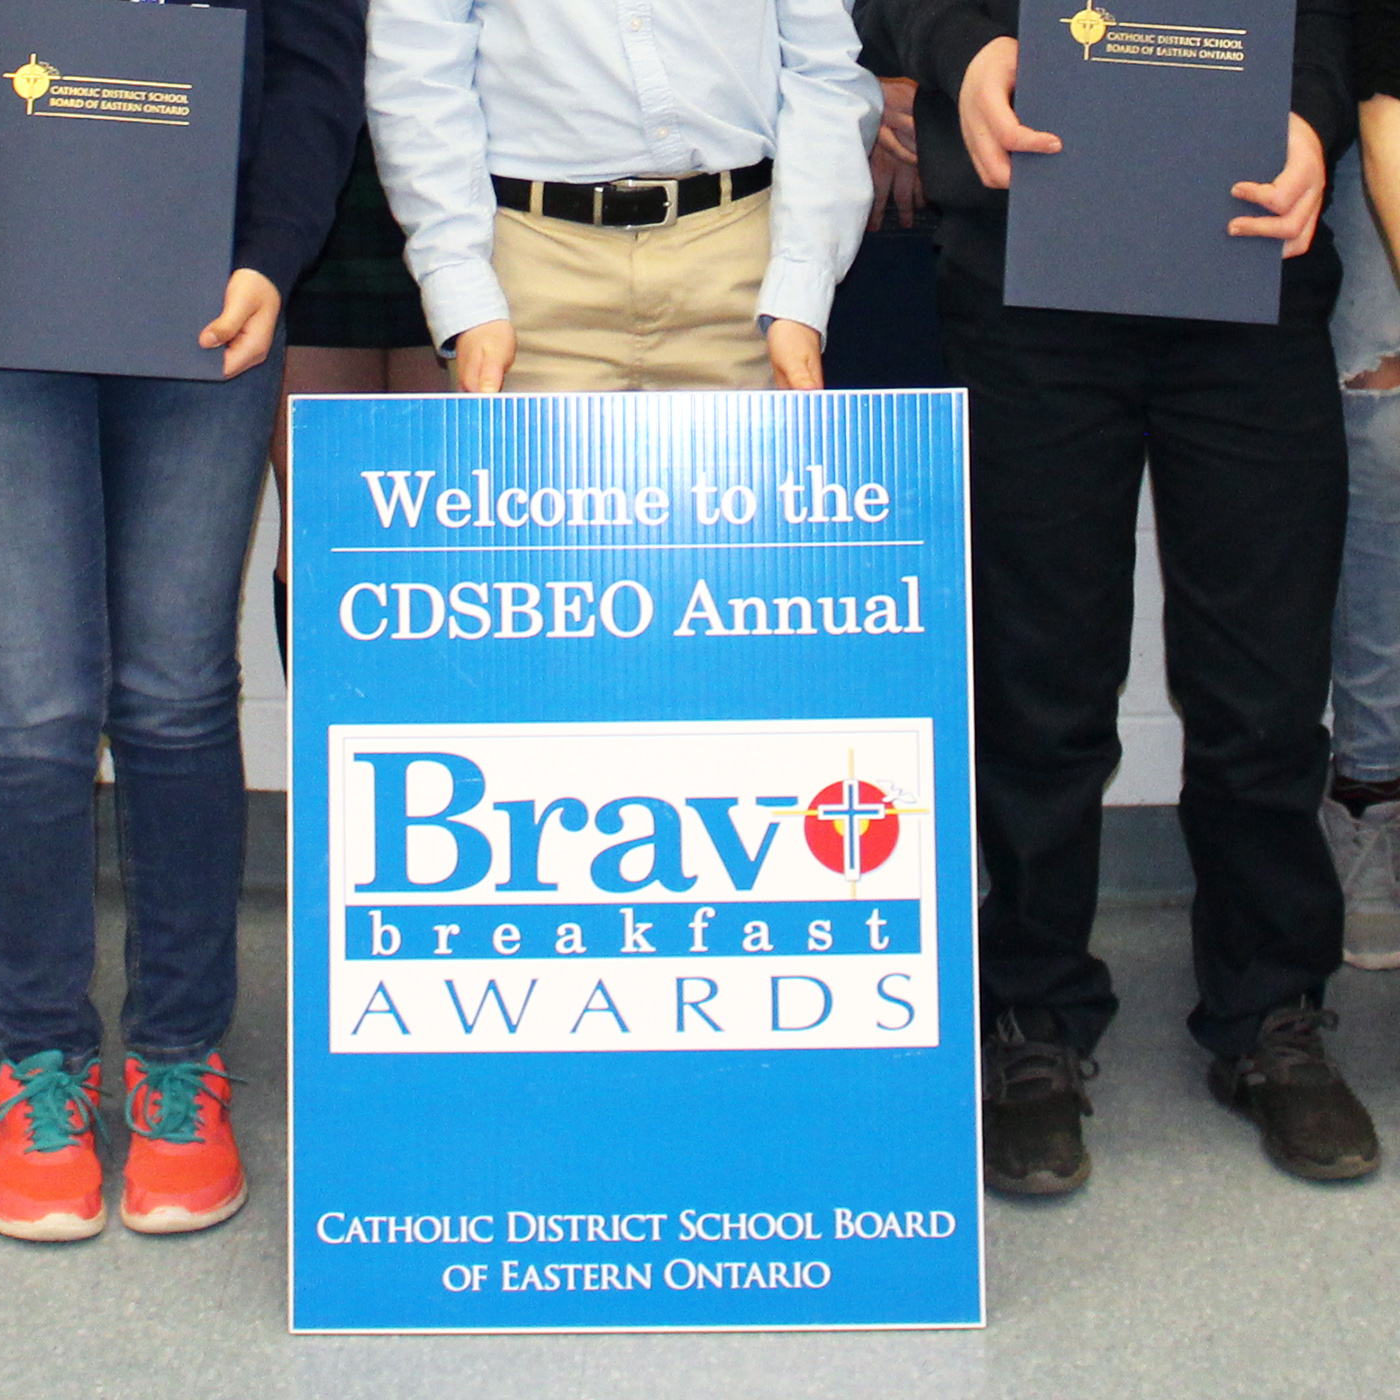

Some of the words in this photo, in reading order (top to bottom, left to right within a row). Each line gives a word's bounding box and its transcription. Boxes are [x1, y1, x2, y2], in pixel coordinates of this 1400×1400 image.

[1105, 43, 1140, 55] BOARD
[1141, 45, 1155, 56] OF
[1199, 50, 1245, 62] ONTARIO
[1106, 32, 1155, 44] CATHOLIC
[1156, 34, 1202, 47] DISTRICT
[1202, 37, 1244, 49] SCHOOL
[49, 85, 100, 98] CATHOLIC
[101, 88, 147, 101] DISTRICT
[147, 92, 189, 104] SCHOOL
[49, 97, 85, 109] BOARD
[84, 99, 99, 110] OF
[99, 101, 142, 113] EASTERN
[143, 104, 190, 116] ONTARIO
[361, 468, 670, 528] Welcome
[690, 470, 757, 526] to
[777, 465, 890, 524] the
[338, 580, 655, 641] CDSBEO
[673, 576, 925, 638] Annual
[369, 905, 891, 956] breakfast
[350, 972, 917, 1035] AWARDS
[316, 1211, 495, 1244] CATHOLIC
[506, 1211, 667, 1243] DISTRICT
[678, 1208, 823, 1241] SCHOOL
[833, 1208, 957, 1240] BOARD
[441, 1264, 489, 1292] OF
[500, 1260, 651, 1292] EASTERN
[663, 1257, 832, 1291] ONTARIO
